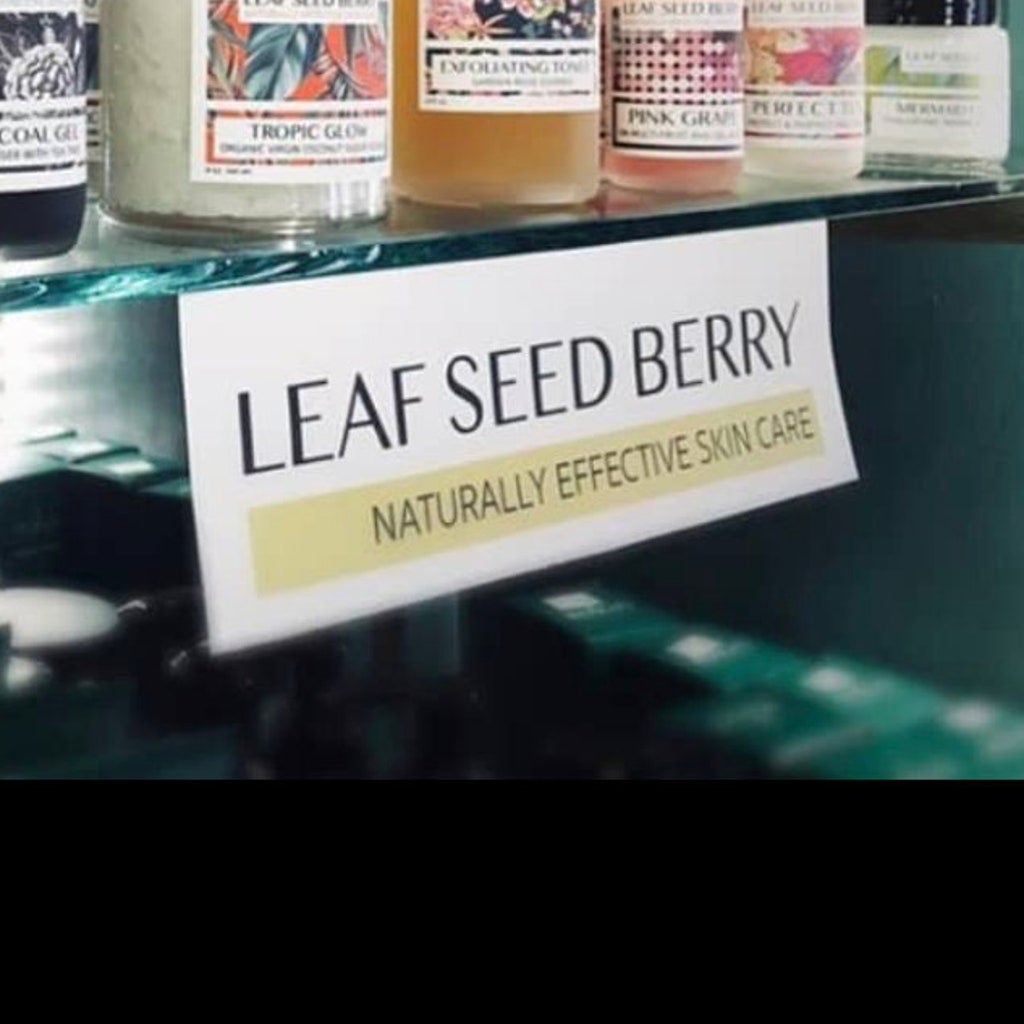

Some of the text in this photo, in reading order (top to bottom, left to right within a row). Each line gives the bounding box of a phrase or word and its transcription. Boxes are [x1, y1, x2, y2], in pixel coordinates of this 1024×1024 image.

[440, 60, 549, 75] EXFOLIATING
[627, 108, 676, 126] PINK
[251, 124, 321, 141] TROPIC
[238, 301, 801, 475] LEAF SEED BERRY
[372, 405, 816, 545] NATURALLY EFFECTIVE SKIN CARE
